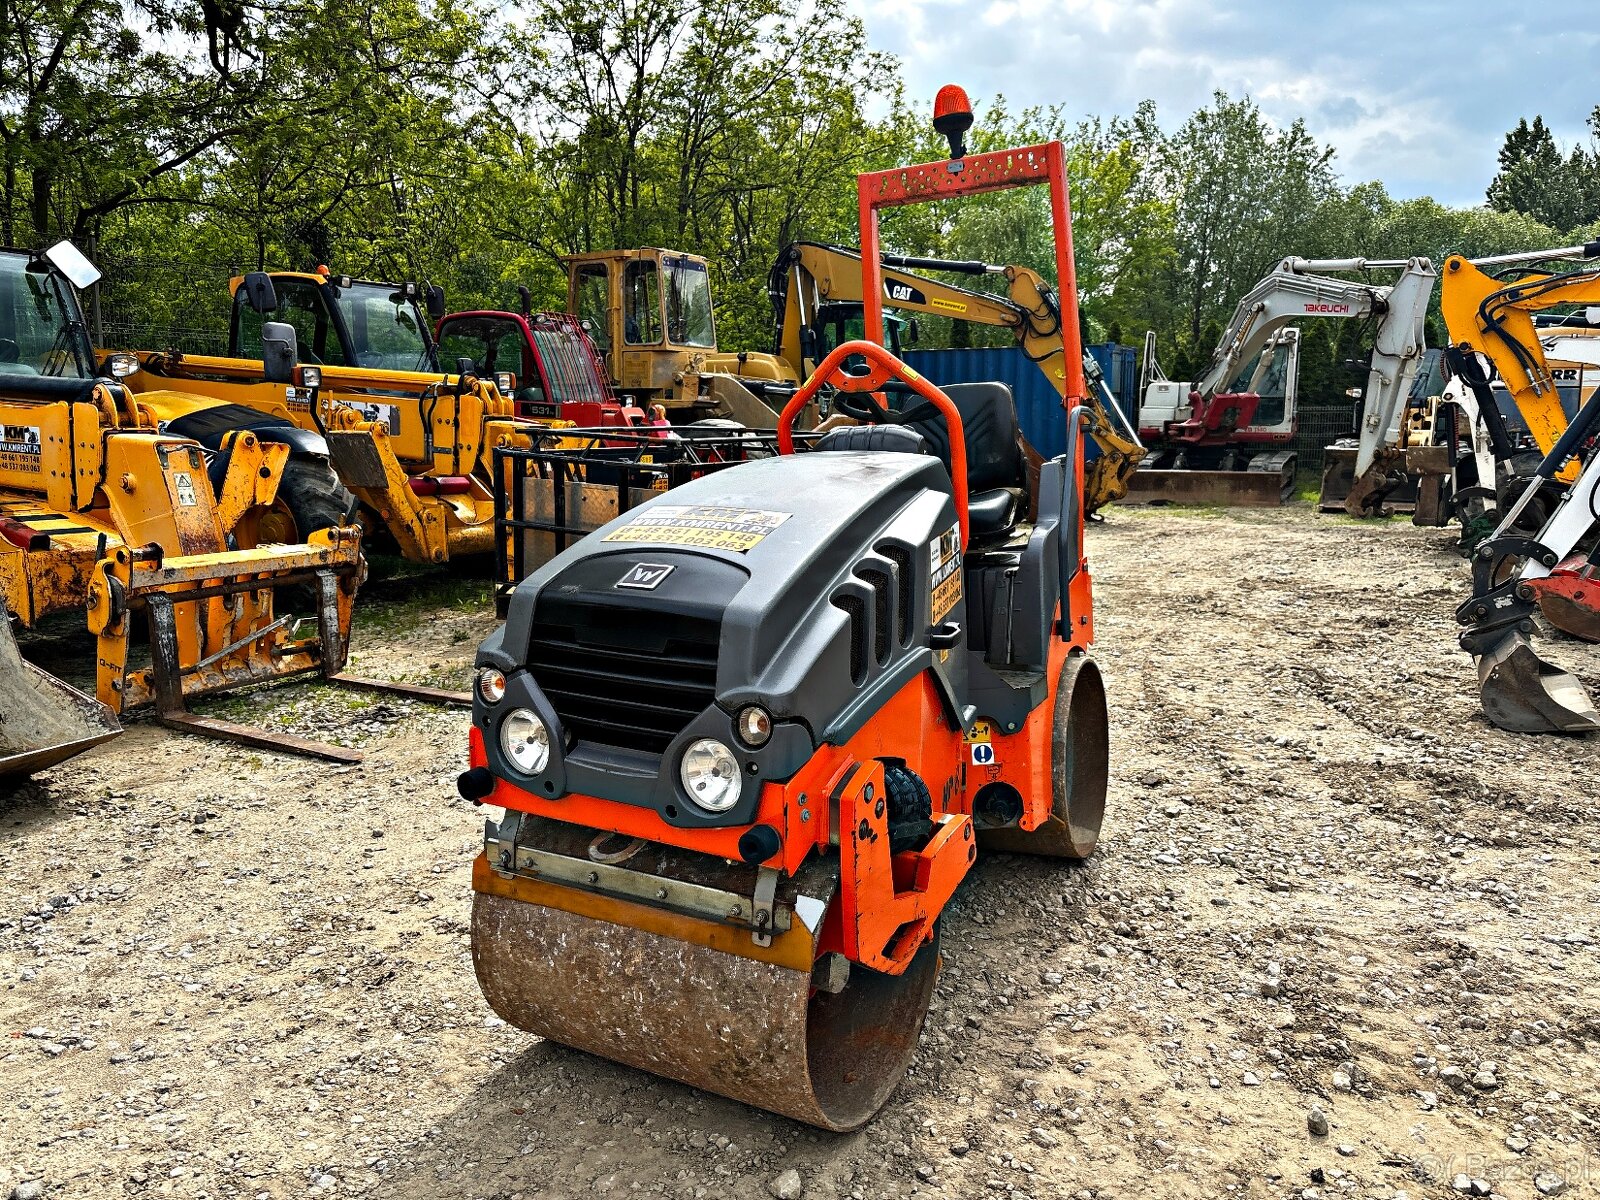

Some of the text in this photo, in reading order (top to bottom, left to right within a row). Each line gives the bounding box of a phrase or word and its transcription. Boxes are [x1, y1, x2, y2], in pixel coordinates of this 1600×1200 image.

[892, 285, 912, 300] CAT
[531, 405, 550, 415] 531
[0, 442, 40, 453] W.KMRENT.PL
[629, 518, 769, 535] WWW.KMRENT.PL
[695, 529, 724, 537] 195
[727, 532, 756, 542] 148
[684, 536, 714, 545] 003
[715, 540, 747, 550] 063
